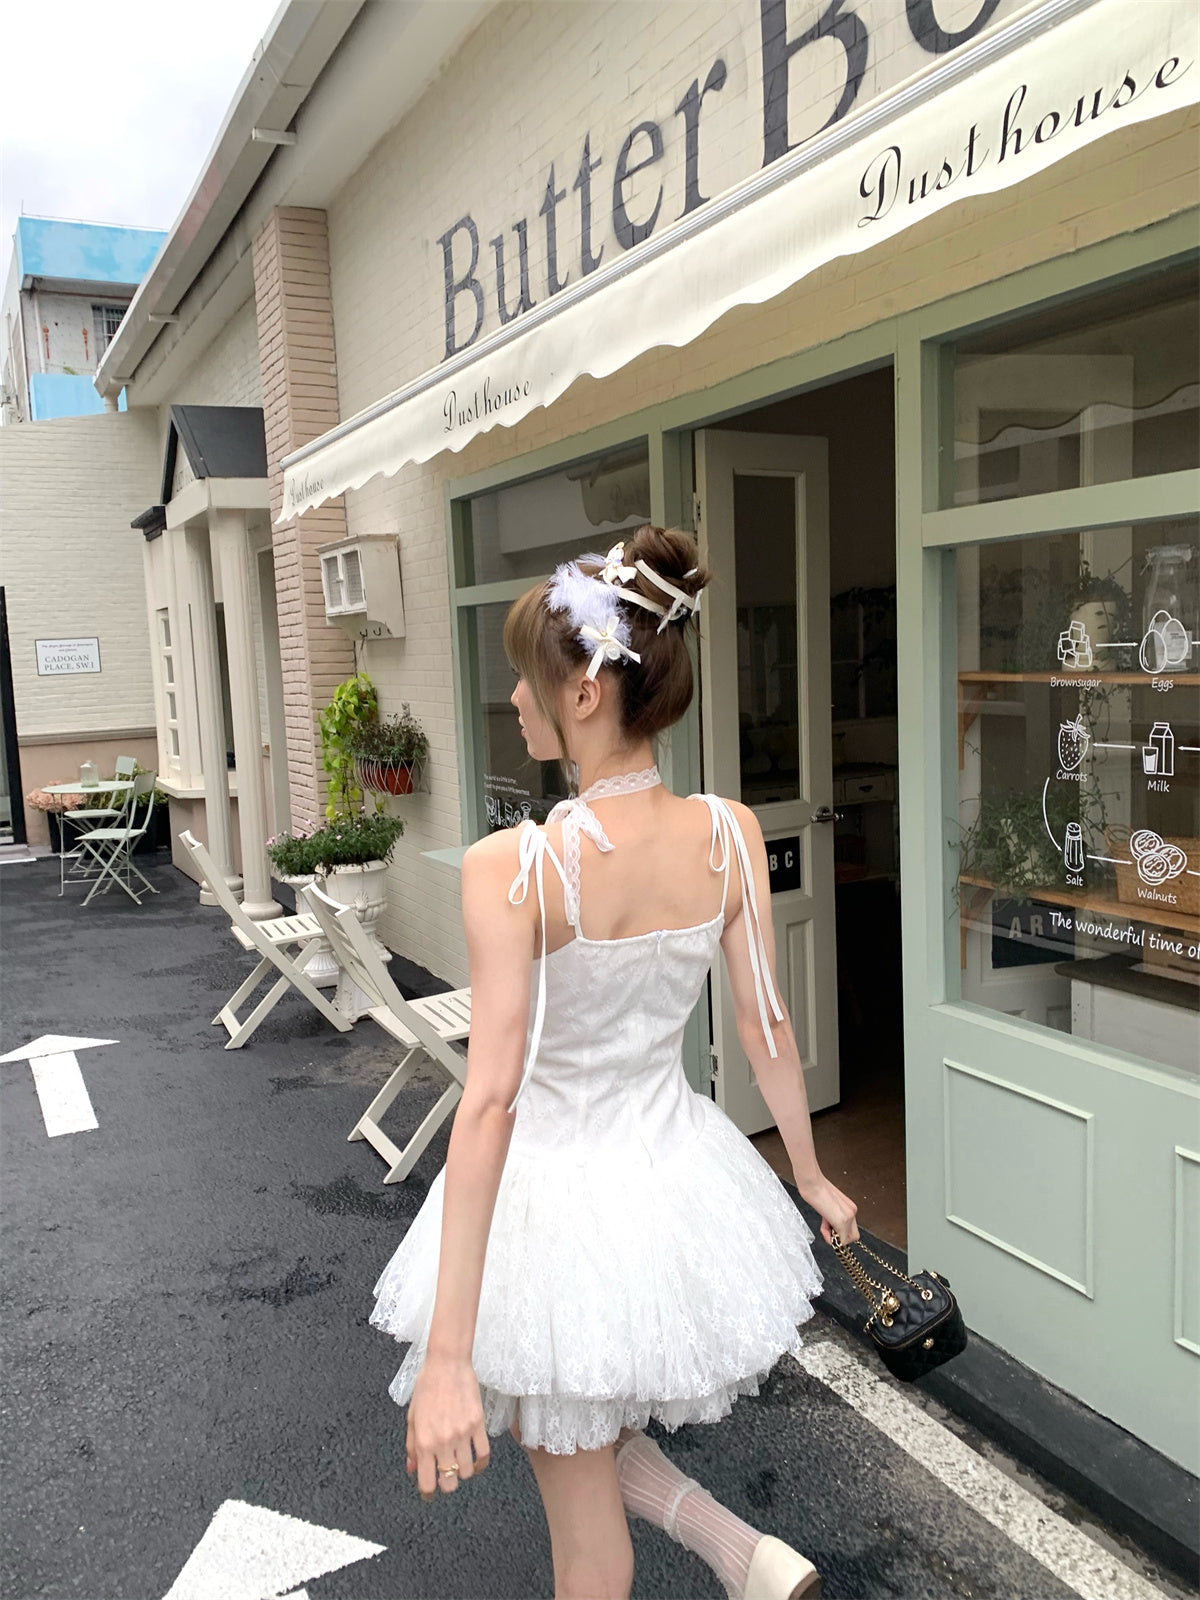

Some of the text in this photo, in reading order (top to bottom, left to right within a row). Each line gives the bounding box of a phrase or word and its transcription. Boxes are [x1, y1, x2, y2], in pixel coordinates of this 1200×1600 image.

[857, 56, 1194, 228] Dusthouse
[436, 58, 728, 364] Butter
[44, 655, 90, 663] CADOGAN
[1050, 676, 1102, 691] Brownsugar
[1151, 677, 1174, 692] Eggs
[1056, 769, 1088, 782] Carrots
[1147, 780, 1170, 792] Milk
[1065, 874, 1084, 886] Salt
[1137, 887, 1178, 904] Walnuts
[1049, 911, 1073, 930] The
[1075, 922, 1145, 947] wonderful
[1148, 933, 1184, 955] time
